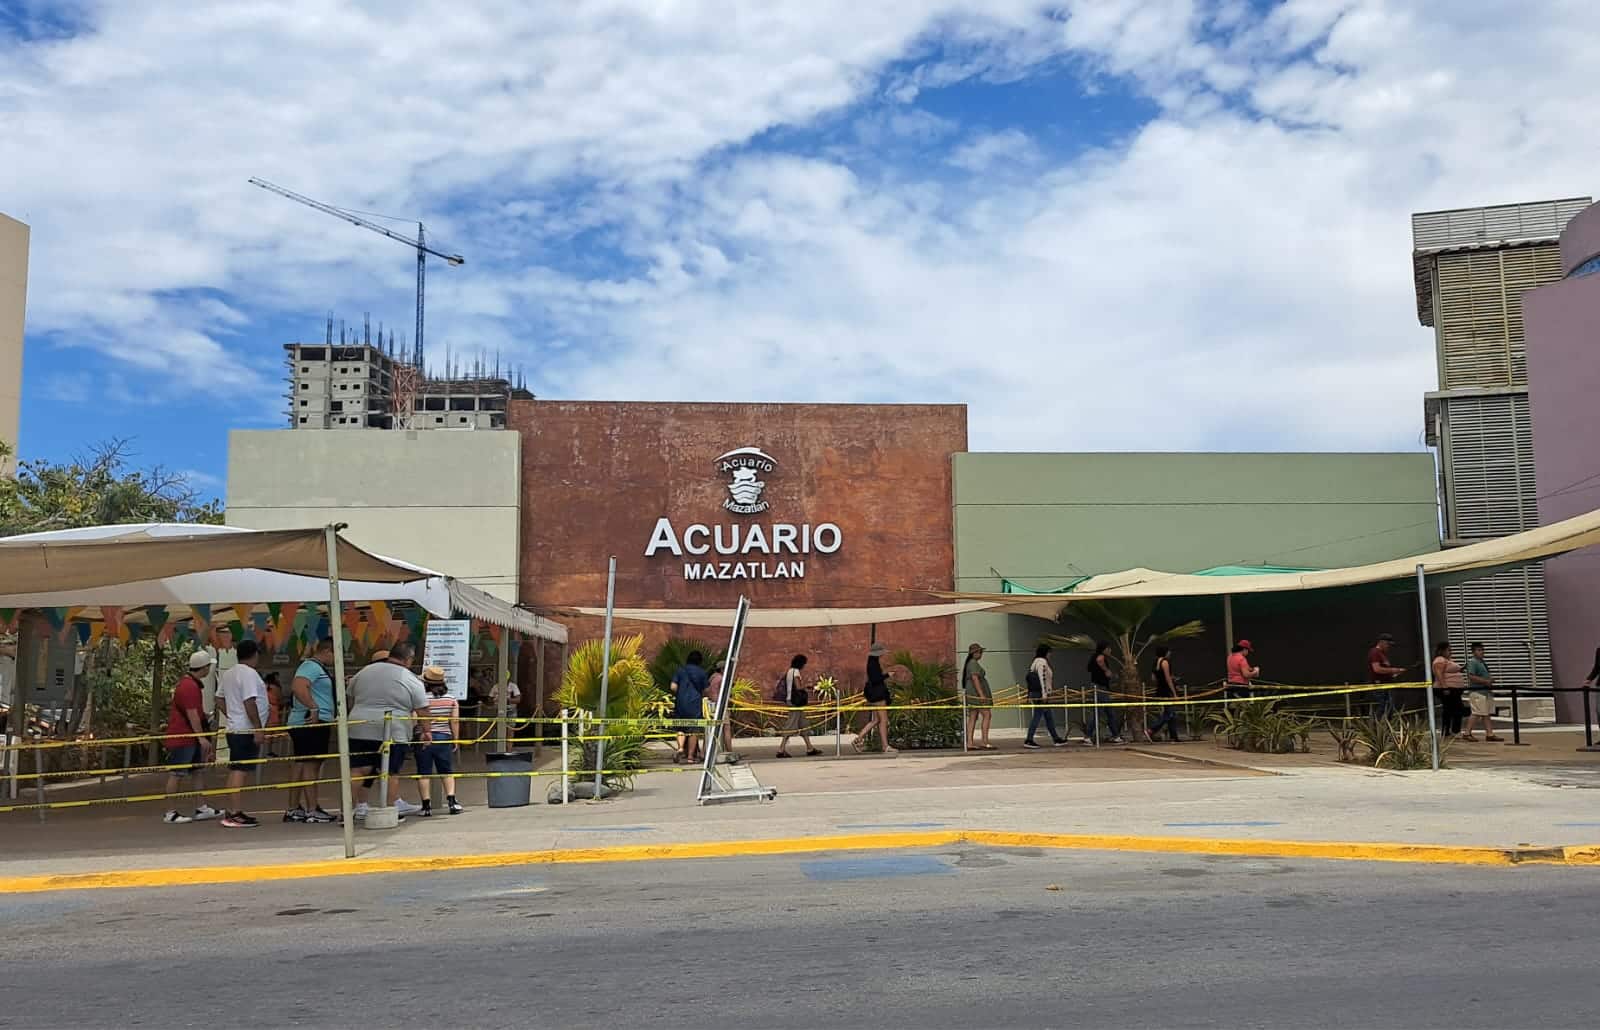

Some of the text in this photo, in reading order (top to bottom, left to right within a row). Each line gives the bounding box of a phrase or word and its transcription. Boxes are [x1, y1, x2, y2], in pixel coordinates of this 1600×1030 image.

[720, 458, 773, 472] Acuario
[644, 518, 841, 555] ACUARIO
[684, 561, 805, 580] MAZATLAN
